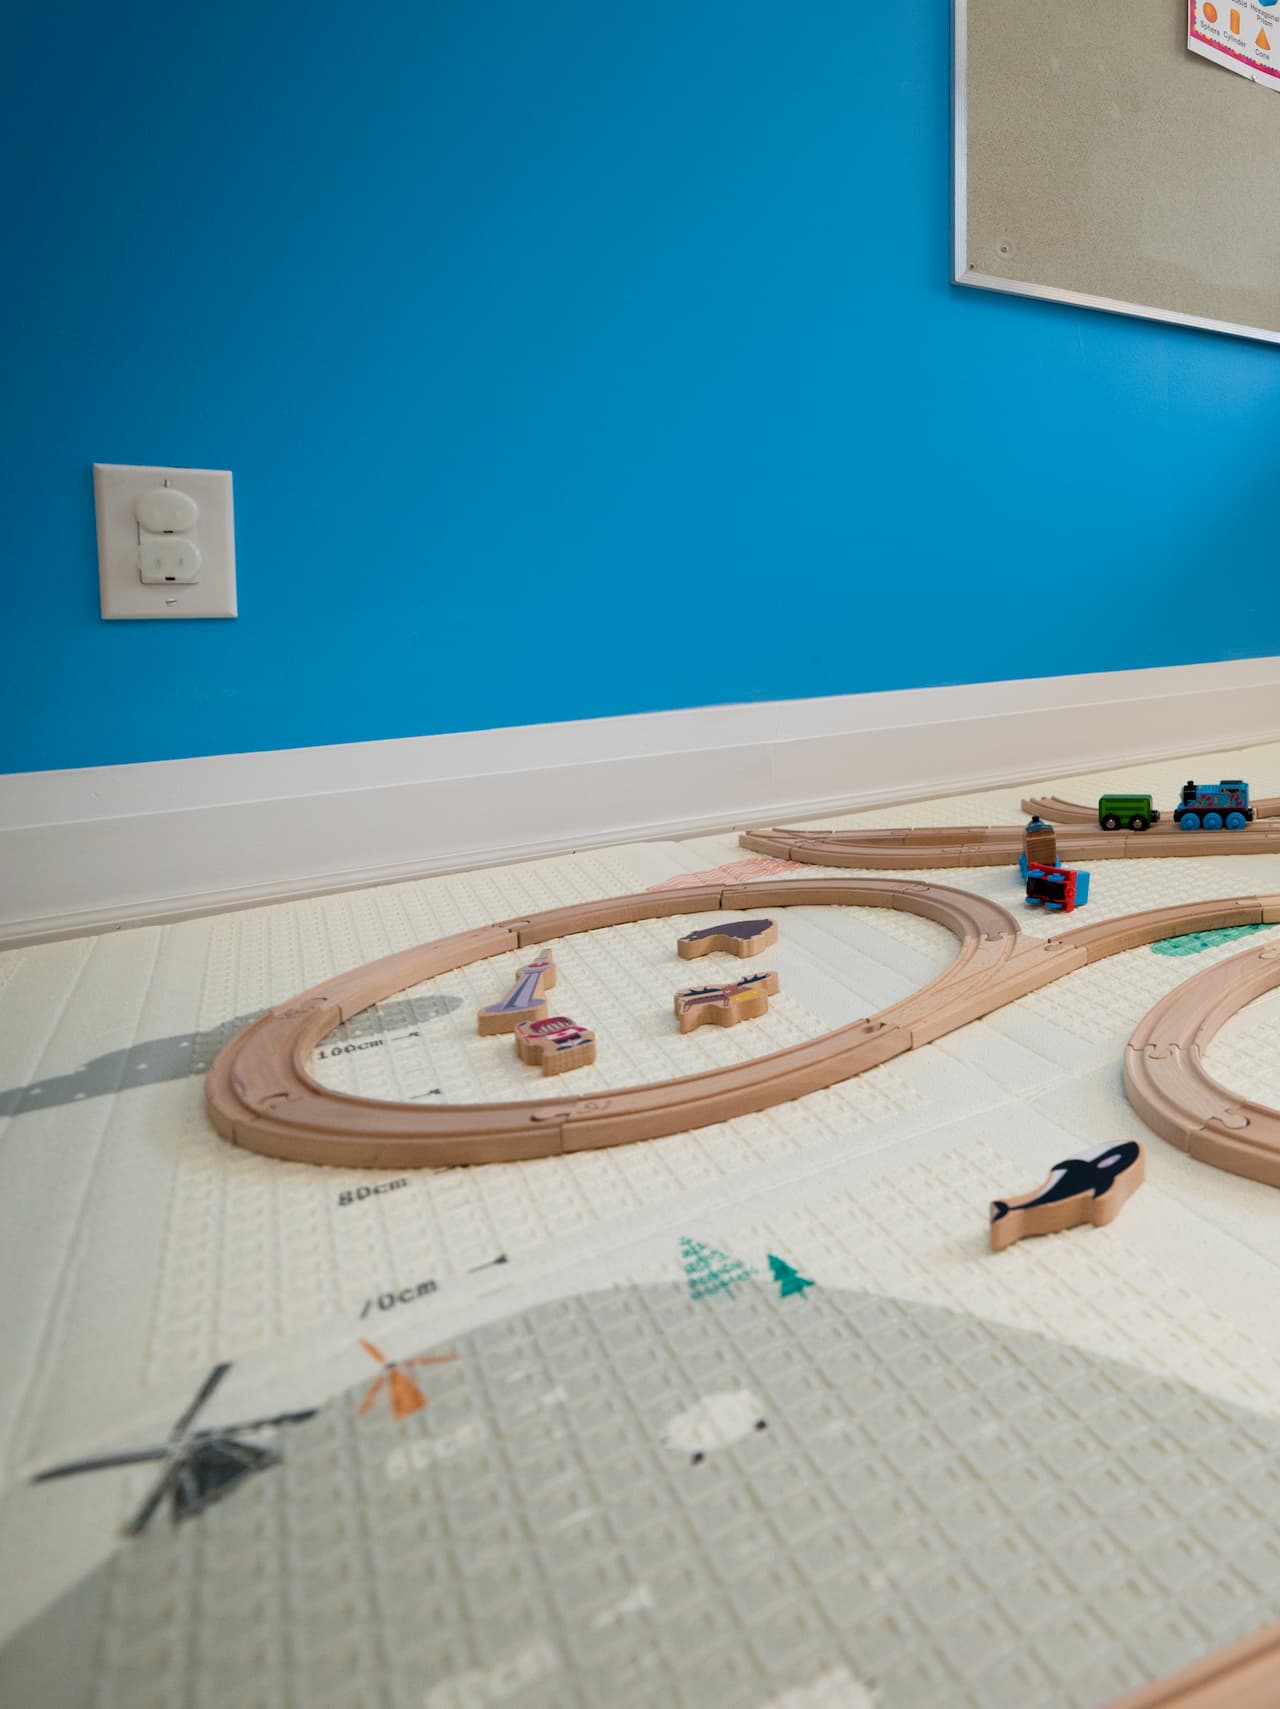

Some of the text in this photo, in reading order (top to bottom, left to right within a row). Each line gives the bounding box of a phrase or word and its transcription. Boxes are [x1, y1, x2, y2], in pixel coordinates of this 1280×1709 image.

[1250, 3, 1280, 23] Hexagonal
[1256, 14, 1273, 27] Prism
[1200, 19, 1221, 36] Sphere
[1223, 30, 1247, 48] Cylinder
[1255, 48, 1271, 60] Cone
[317, 1038, 384, 1060] 100cm
[337, 1178, 408, 1206] 80cm
